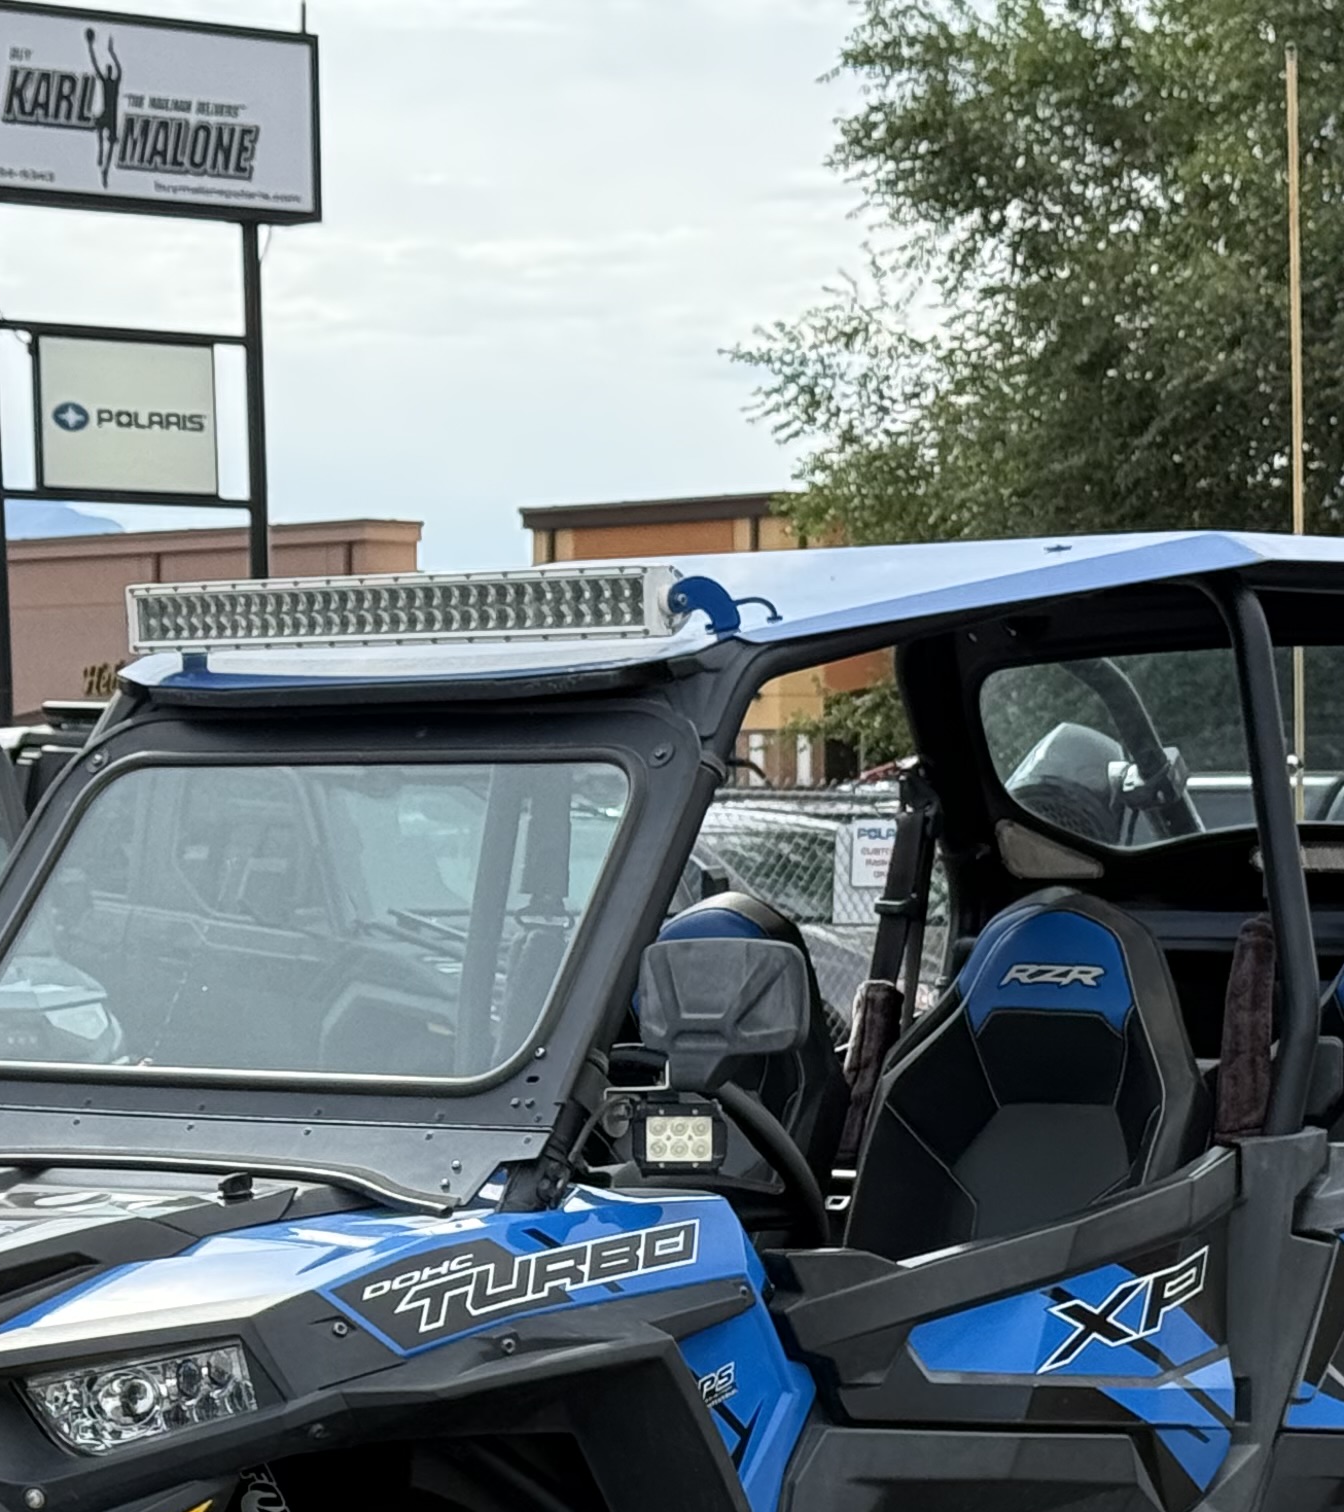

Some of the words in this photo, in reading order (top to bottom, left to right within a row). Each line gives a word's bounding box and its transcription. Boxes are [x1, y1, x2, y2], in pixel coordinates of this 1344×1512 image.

[2, 67, 96, 128] KARL
[117, 114, 259, 179] MALONE
[96, 408, 207, 433] POLARIS
[999, 964, 1105, 987] RZR
[362, 1253, 474, 1301] DOHC
[394, 1219, 701, 1333] TURBO
[1035, 1245, 1209, 1375] XP
